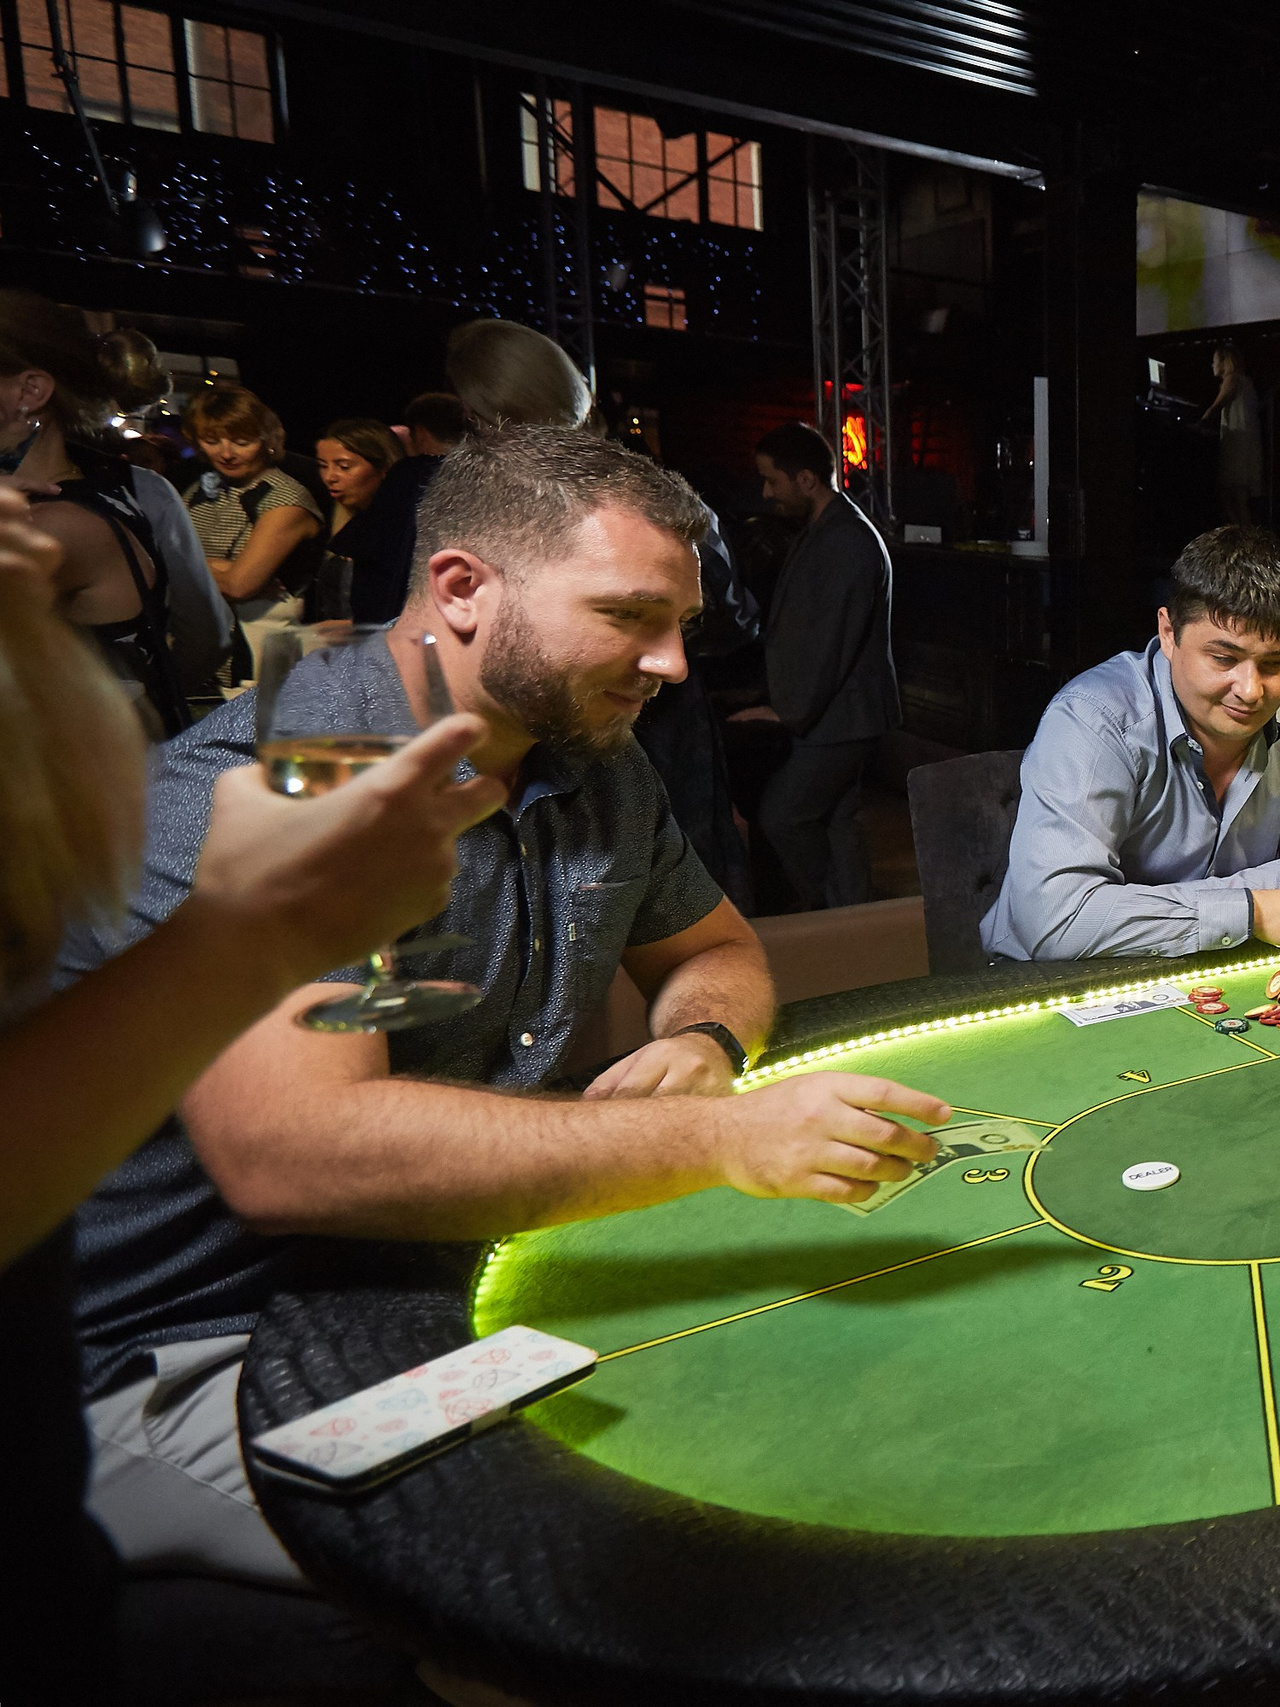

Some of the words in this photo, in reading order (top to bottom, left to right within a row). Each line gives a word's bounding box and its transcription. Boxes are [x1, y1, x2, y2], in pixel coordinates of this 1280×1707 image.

[1116, 1069, 1151, 1083] 4
[962, 1168, 1010, 1184] 3
[1128, 1166, 1172, 1180] DEALER
[1078, 1263, 1134, 1292] 2
